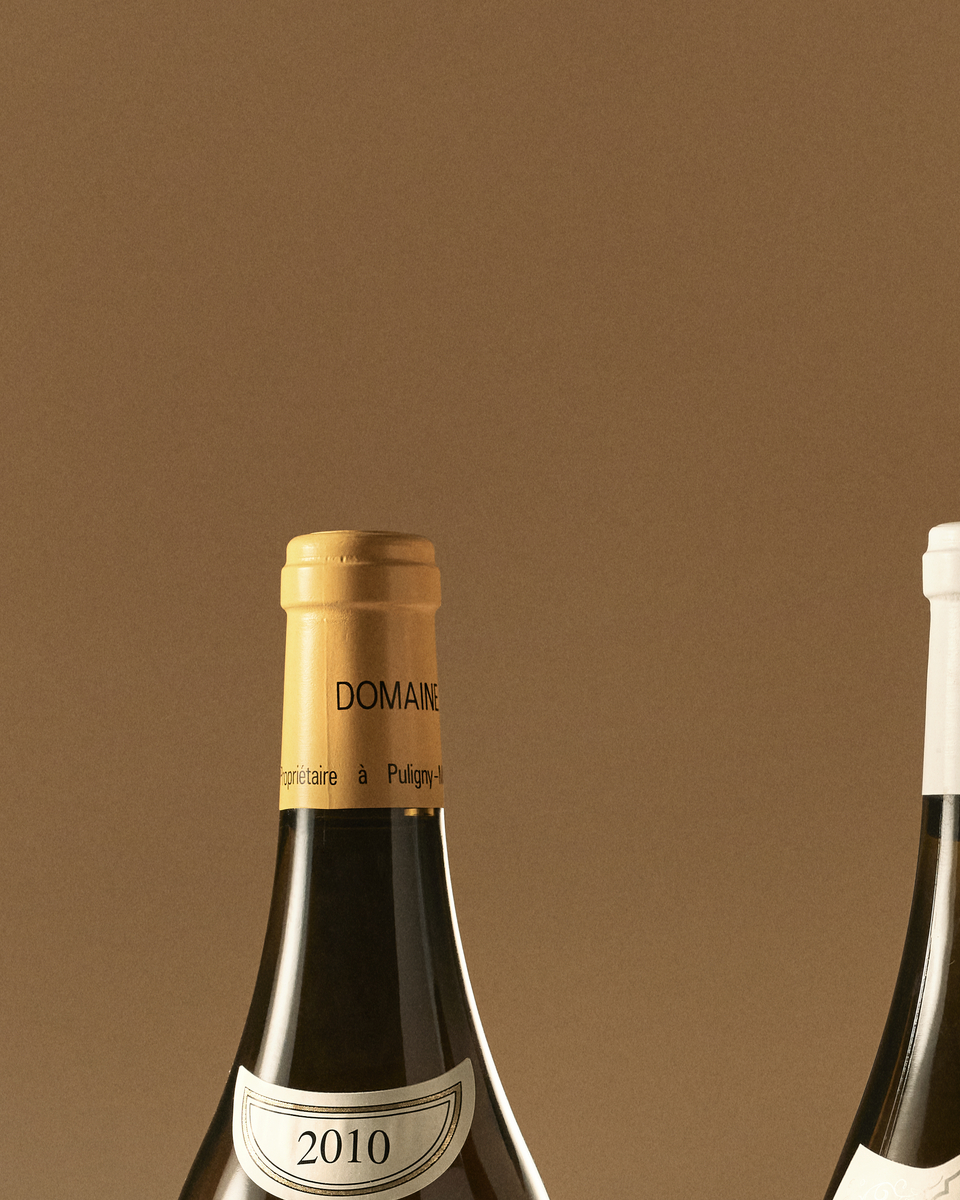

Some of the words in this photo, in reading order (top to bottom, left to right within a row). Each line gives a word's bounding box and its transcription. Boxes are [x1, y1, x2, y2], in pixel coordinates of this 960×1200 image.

[336, 680, 439, 712] DOMAINE
[358, 763, 368, 785] à
[296, 1129, 391, 1166] 2010
